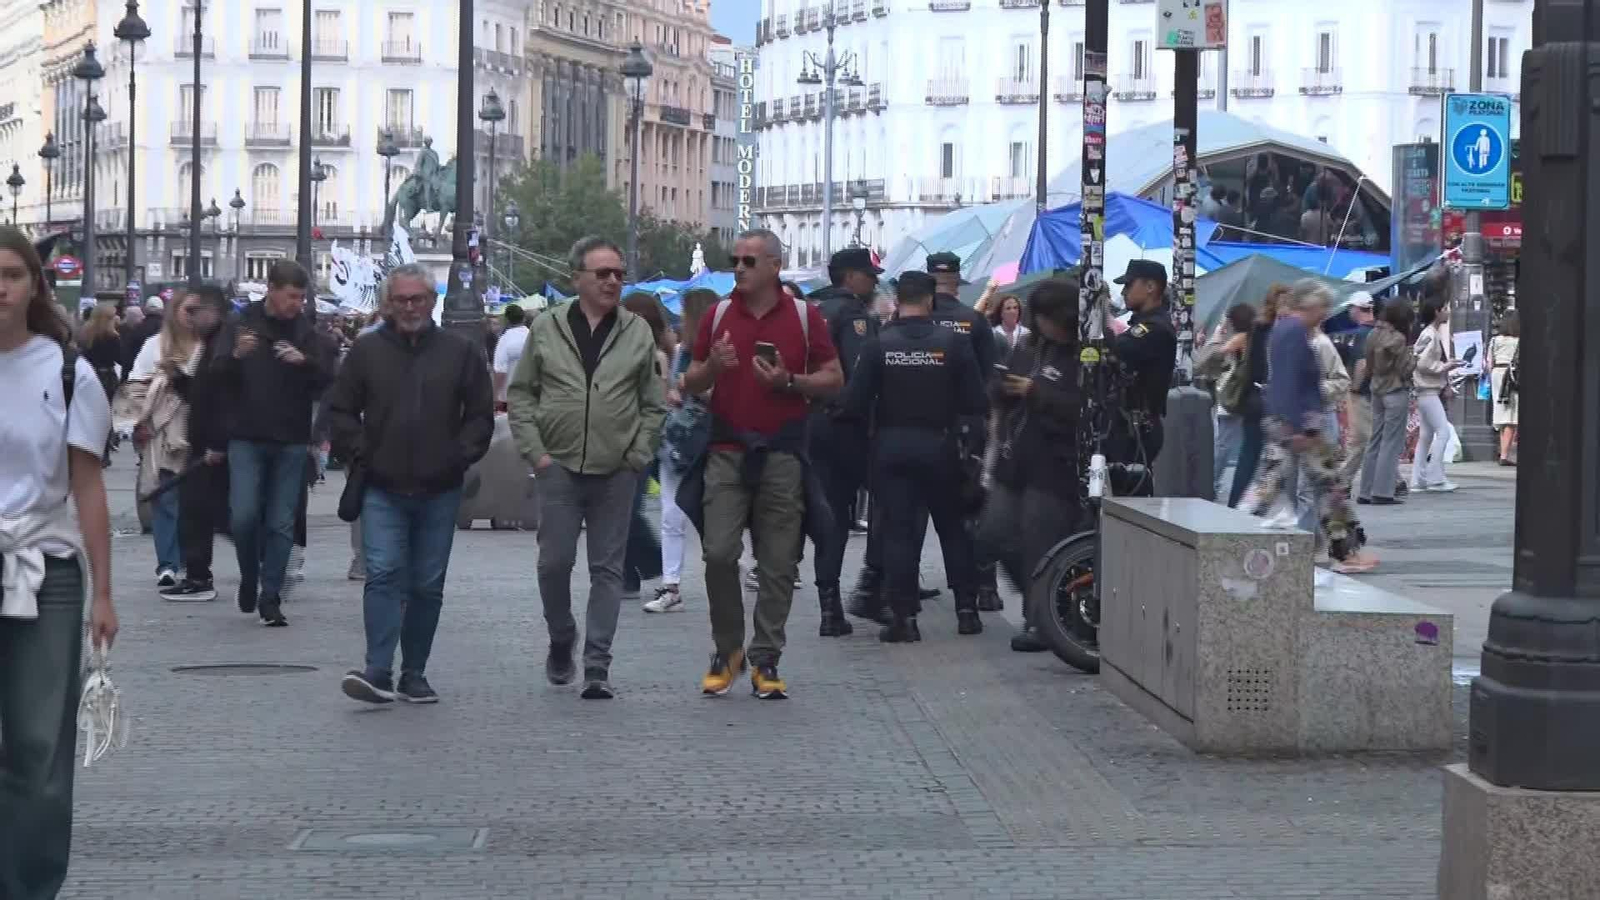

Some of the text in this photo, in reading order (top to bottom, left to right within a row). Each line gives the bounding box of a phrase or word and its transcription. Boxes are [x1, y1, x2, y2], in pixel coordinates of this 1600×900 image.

[739, 58, 753, 133] HOTEL
[1469, 100, 1505, 110] ZONA
[885, 351, 932, 359] POLICIA
